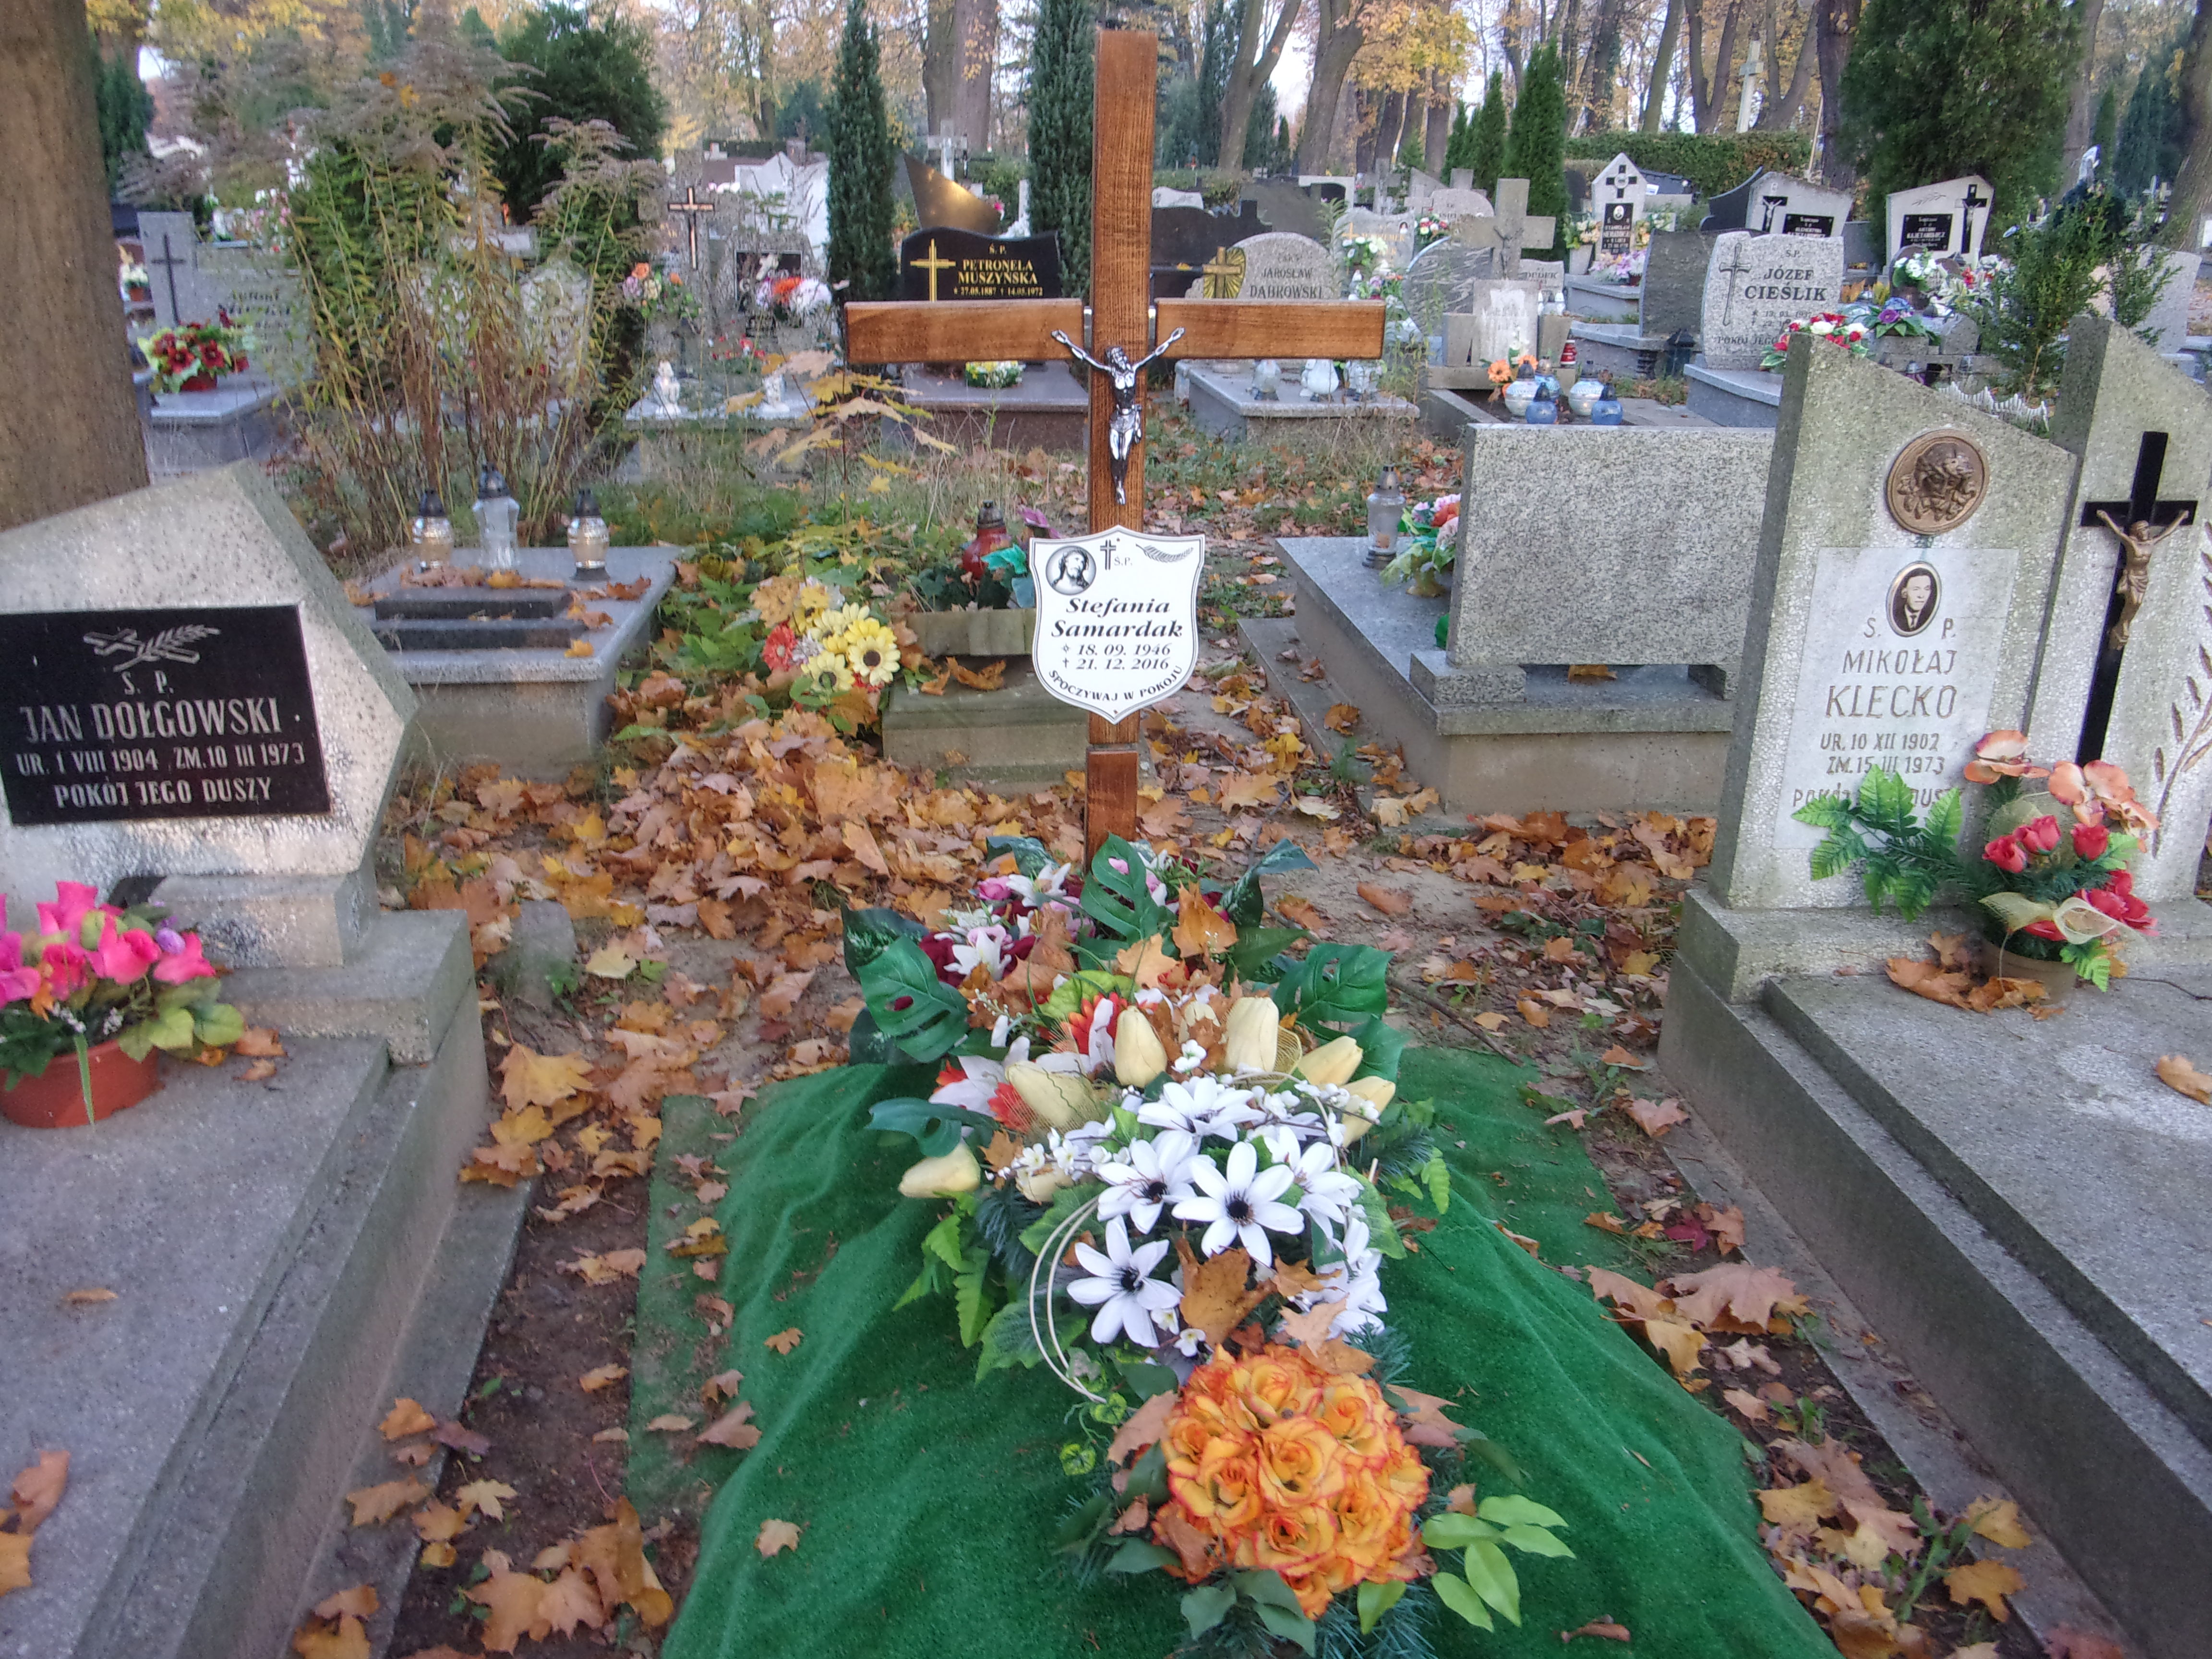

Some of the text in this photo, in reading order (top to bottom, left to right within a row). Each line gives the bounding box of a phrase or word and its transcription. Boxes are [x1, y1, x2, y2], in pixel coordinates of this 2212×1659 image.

[963, 259, 1034, 271] PETRONELA
[1764, 264, 1815, 280] JÓZEF
[1744, 281, 1827, 301] CIEŚLIK
[1066, 597, 1170, 618] Stefania
[1051, 619, 1183, 638] Samardak
[1078, 643, 1173, 656] 18. 09. 1946
[1076, 657, 1171, 670] 21. 12. 2016
[1842, 648, 1958, 675] MIKOŁAJ
[1049, 665, 1183, 701] SPOCZYWAJ W POKOJU
[1825, 685, 1958, 720] KLECKO
[19, 696, 283, 744] JAN DOŁGOWSKI
[1820, 733, 1940, 752] UR. 10 XII 1902
[16, 752, 50, 776] UR.
[72, 749, 108, 773] VIII
[111, 747, 159, 772] 1904
[234, 744, 256, 767] III
[260, 742, 305, 766] 1973
[1881, 756, 1899, 773] III
[1905, 756, 1945, 775] 1973
[54, 775, 272, 809] POKÓJ JEGO DUSZY
